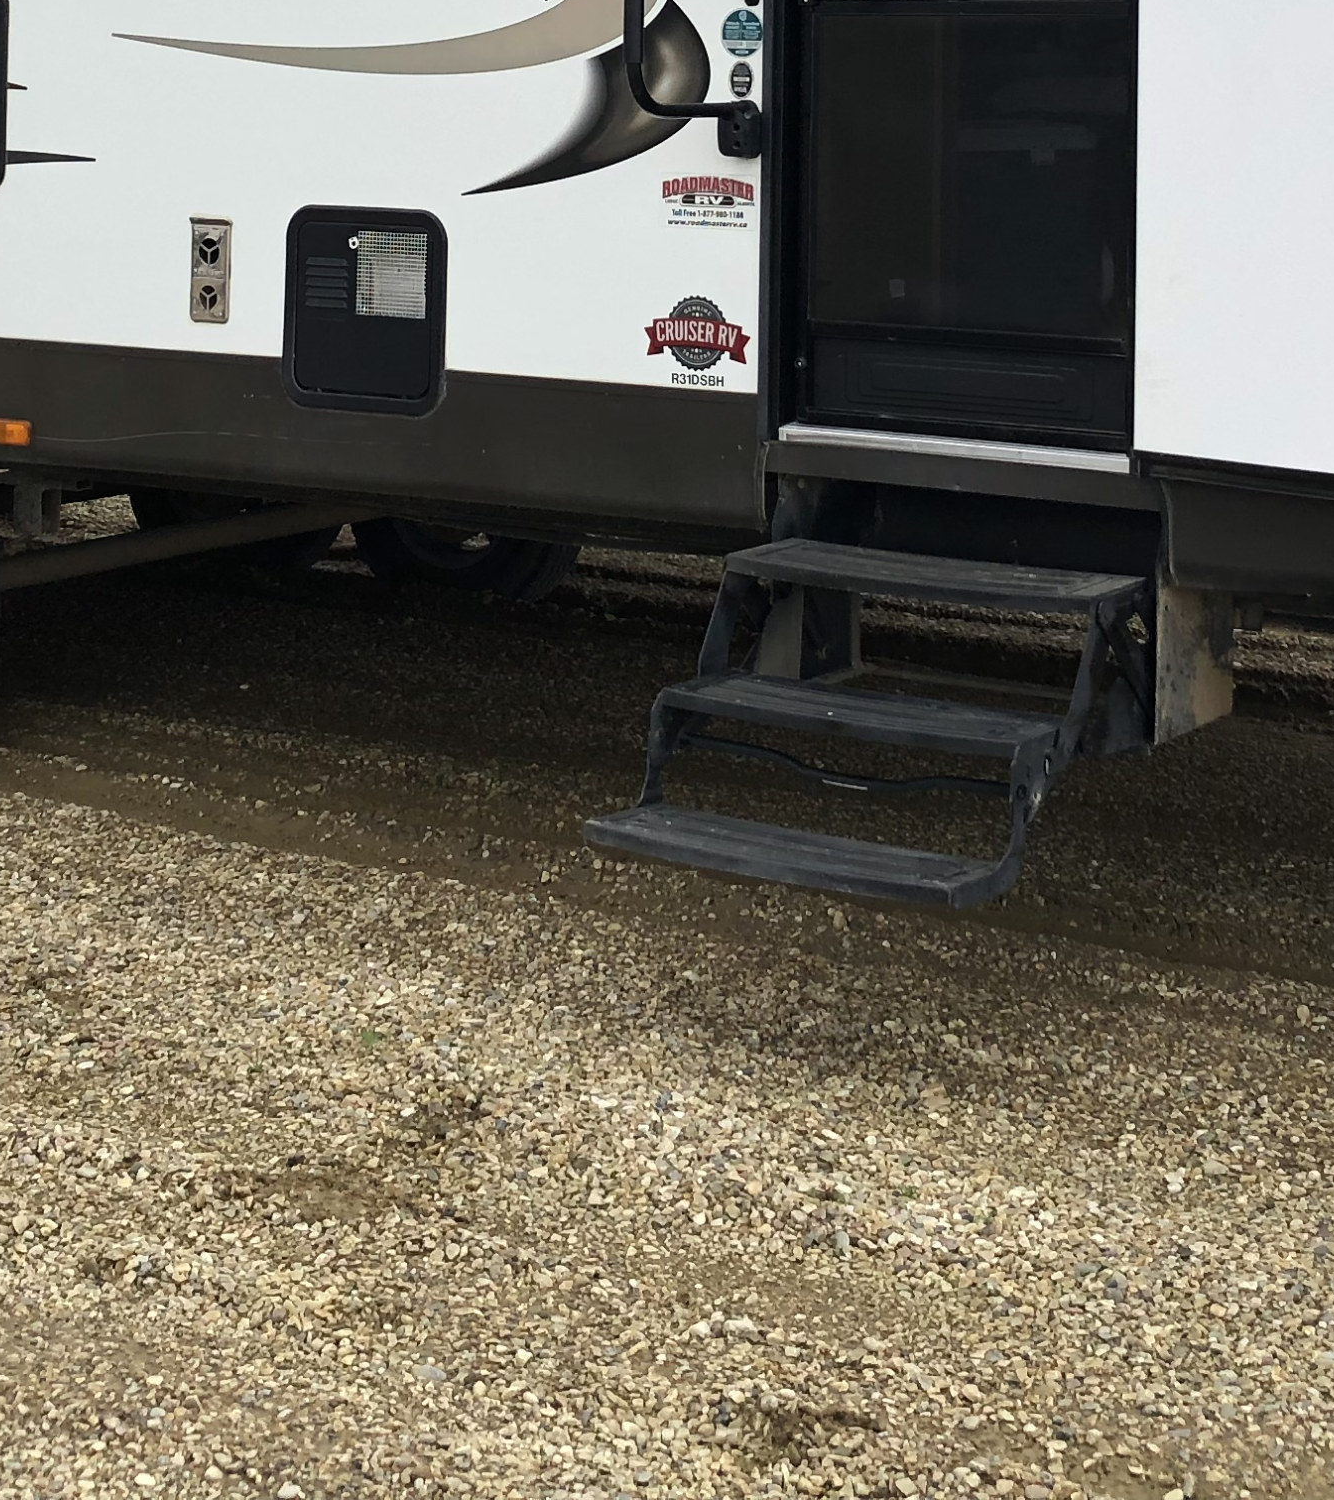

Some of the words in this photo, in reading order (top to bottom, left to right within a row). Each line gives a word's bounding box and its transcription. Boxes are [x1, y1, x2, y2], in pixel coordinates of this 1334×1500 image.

[662, 176, 754, 201] ROADMASTER
[694, 195, 724, 205] RV
[683, 209, 696, 217] Free
[655, 319, 715, 344] CRUISER
[717, 324, 738, 348] RV
[671, 372, 725, 387] R31DSBH
